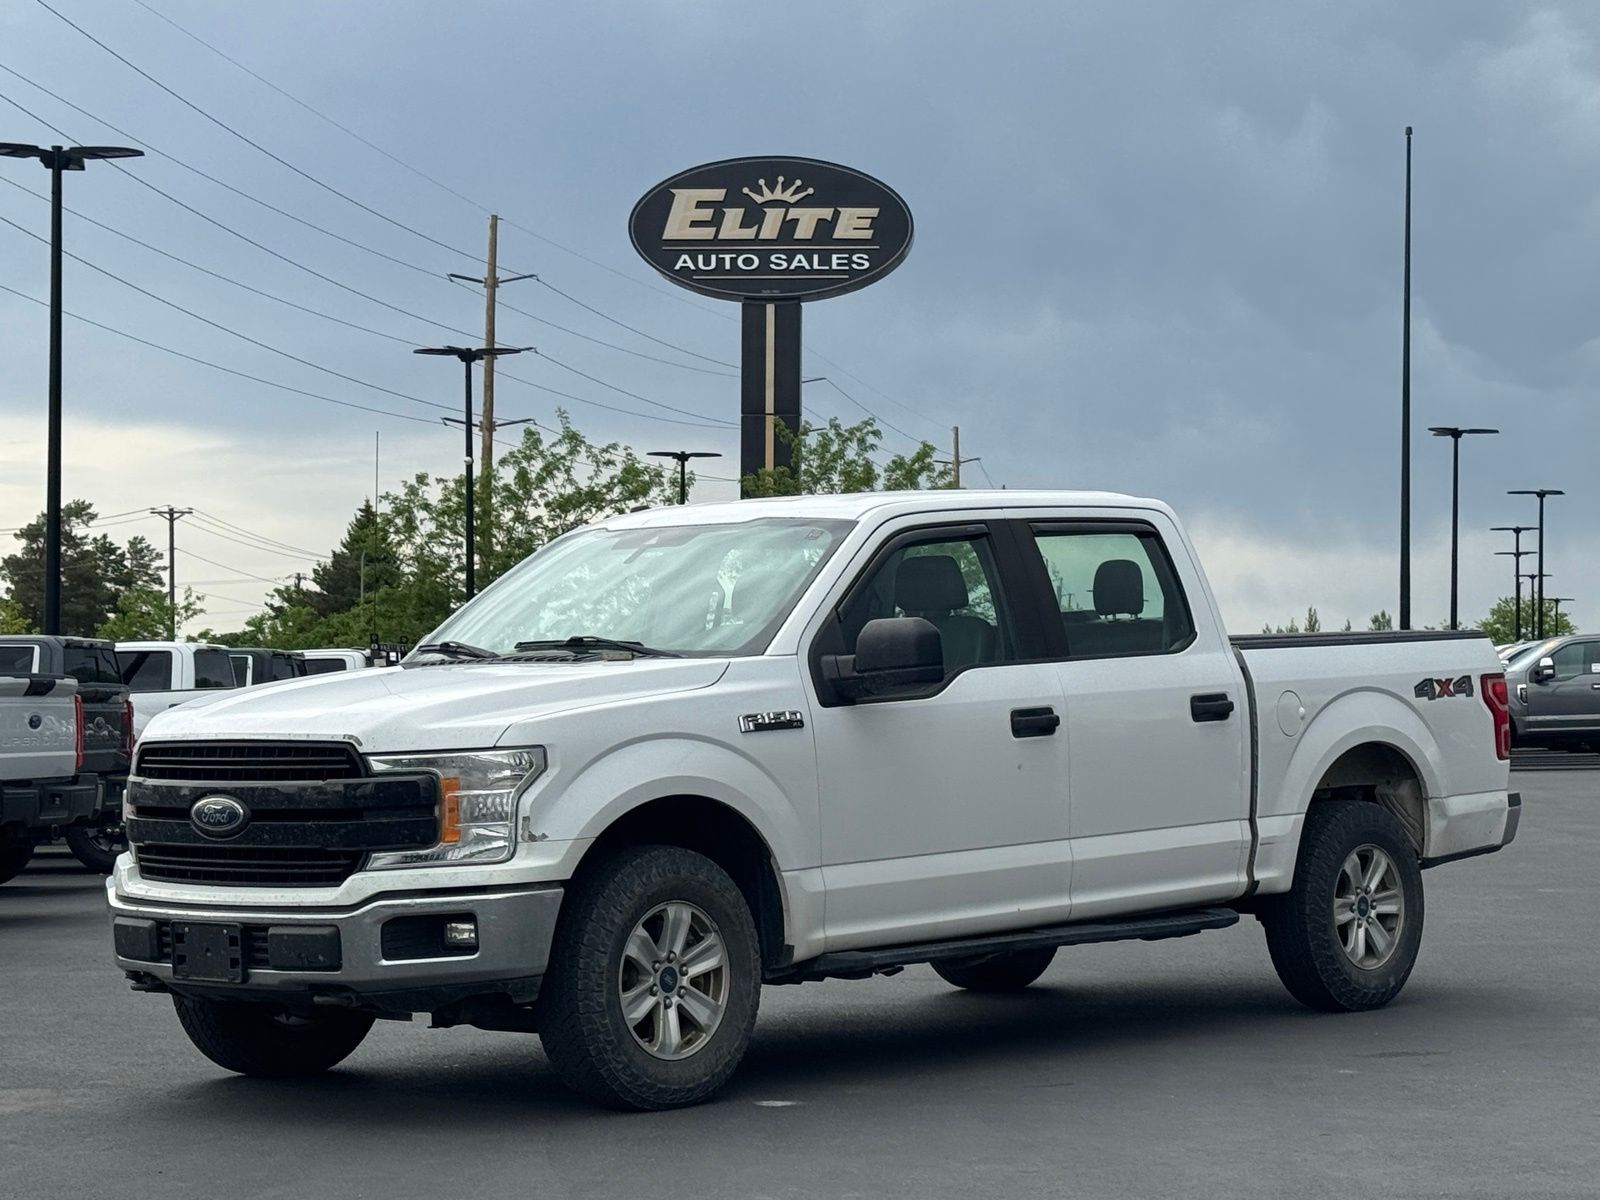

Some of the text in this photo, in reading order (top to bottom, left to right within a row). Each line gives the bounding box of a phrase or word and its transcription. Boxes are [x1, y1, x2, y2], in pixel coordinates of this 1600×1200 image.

[661, 188, 880, 240] ELITE
[674, 254, 870, 271] AUTO SALES
[201, 804, 230, 823] Ford
